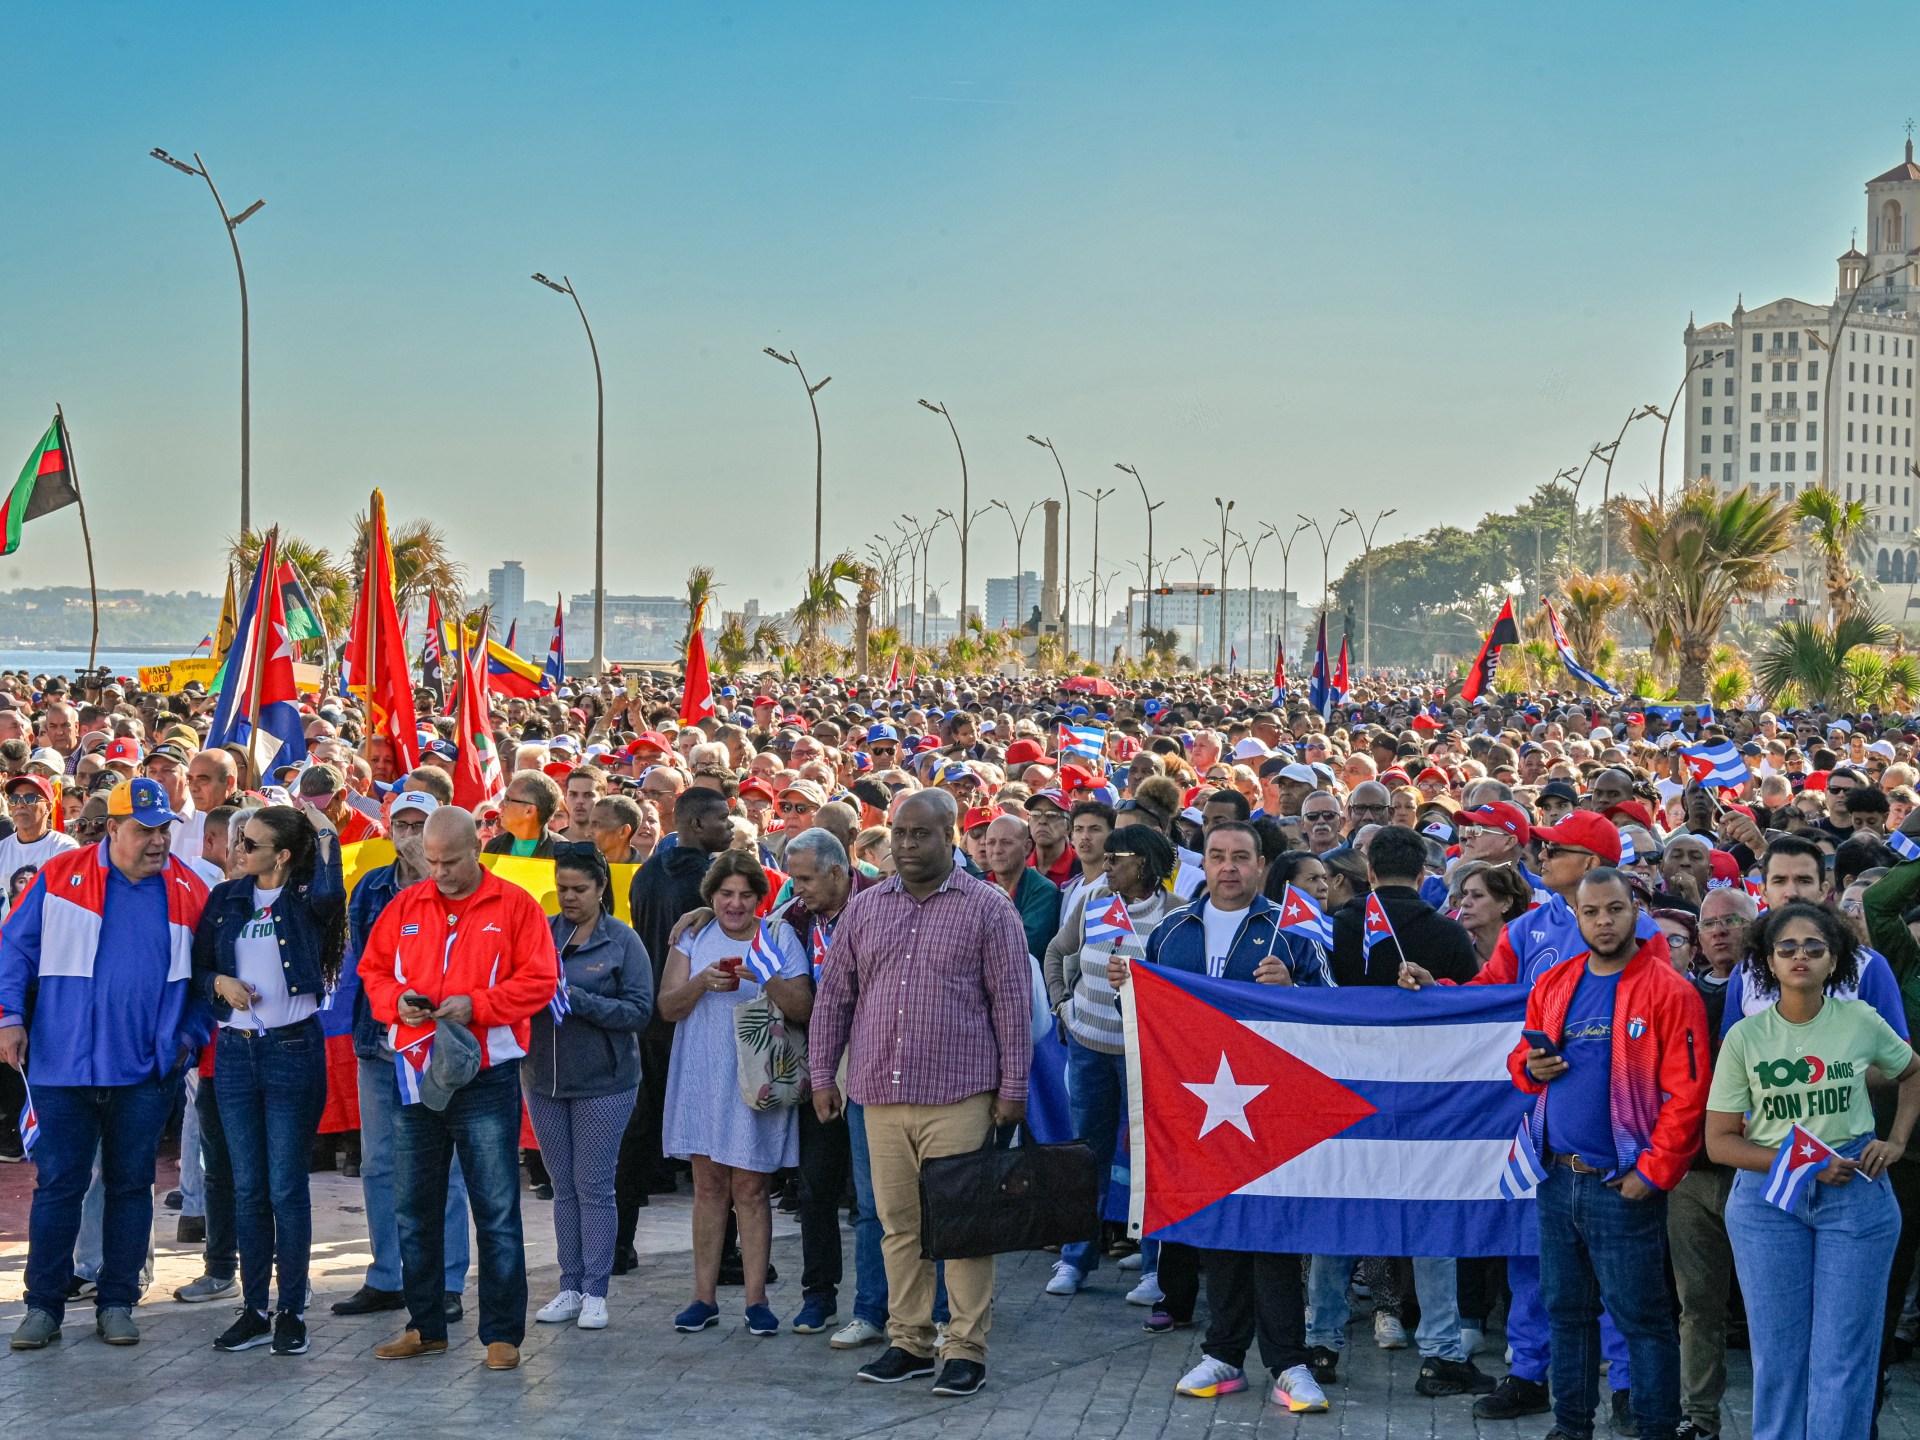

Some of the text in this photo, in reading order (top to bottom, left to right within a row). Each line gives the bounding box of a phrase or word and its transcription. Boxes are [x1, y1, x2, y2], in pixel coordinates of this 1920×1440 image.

[252, 922, 275, 939] FID
[1753, 1055, 1854, 1090] 100 AÑOS
[1762, 1093, 1803, 1121] CON
